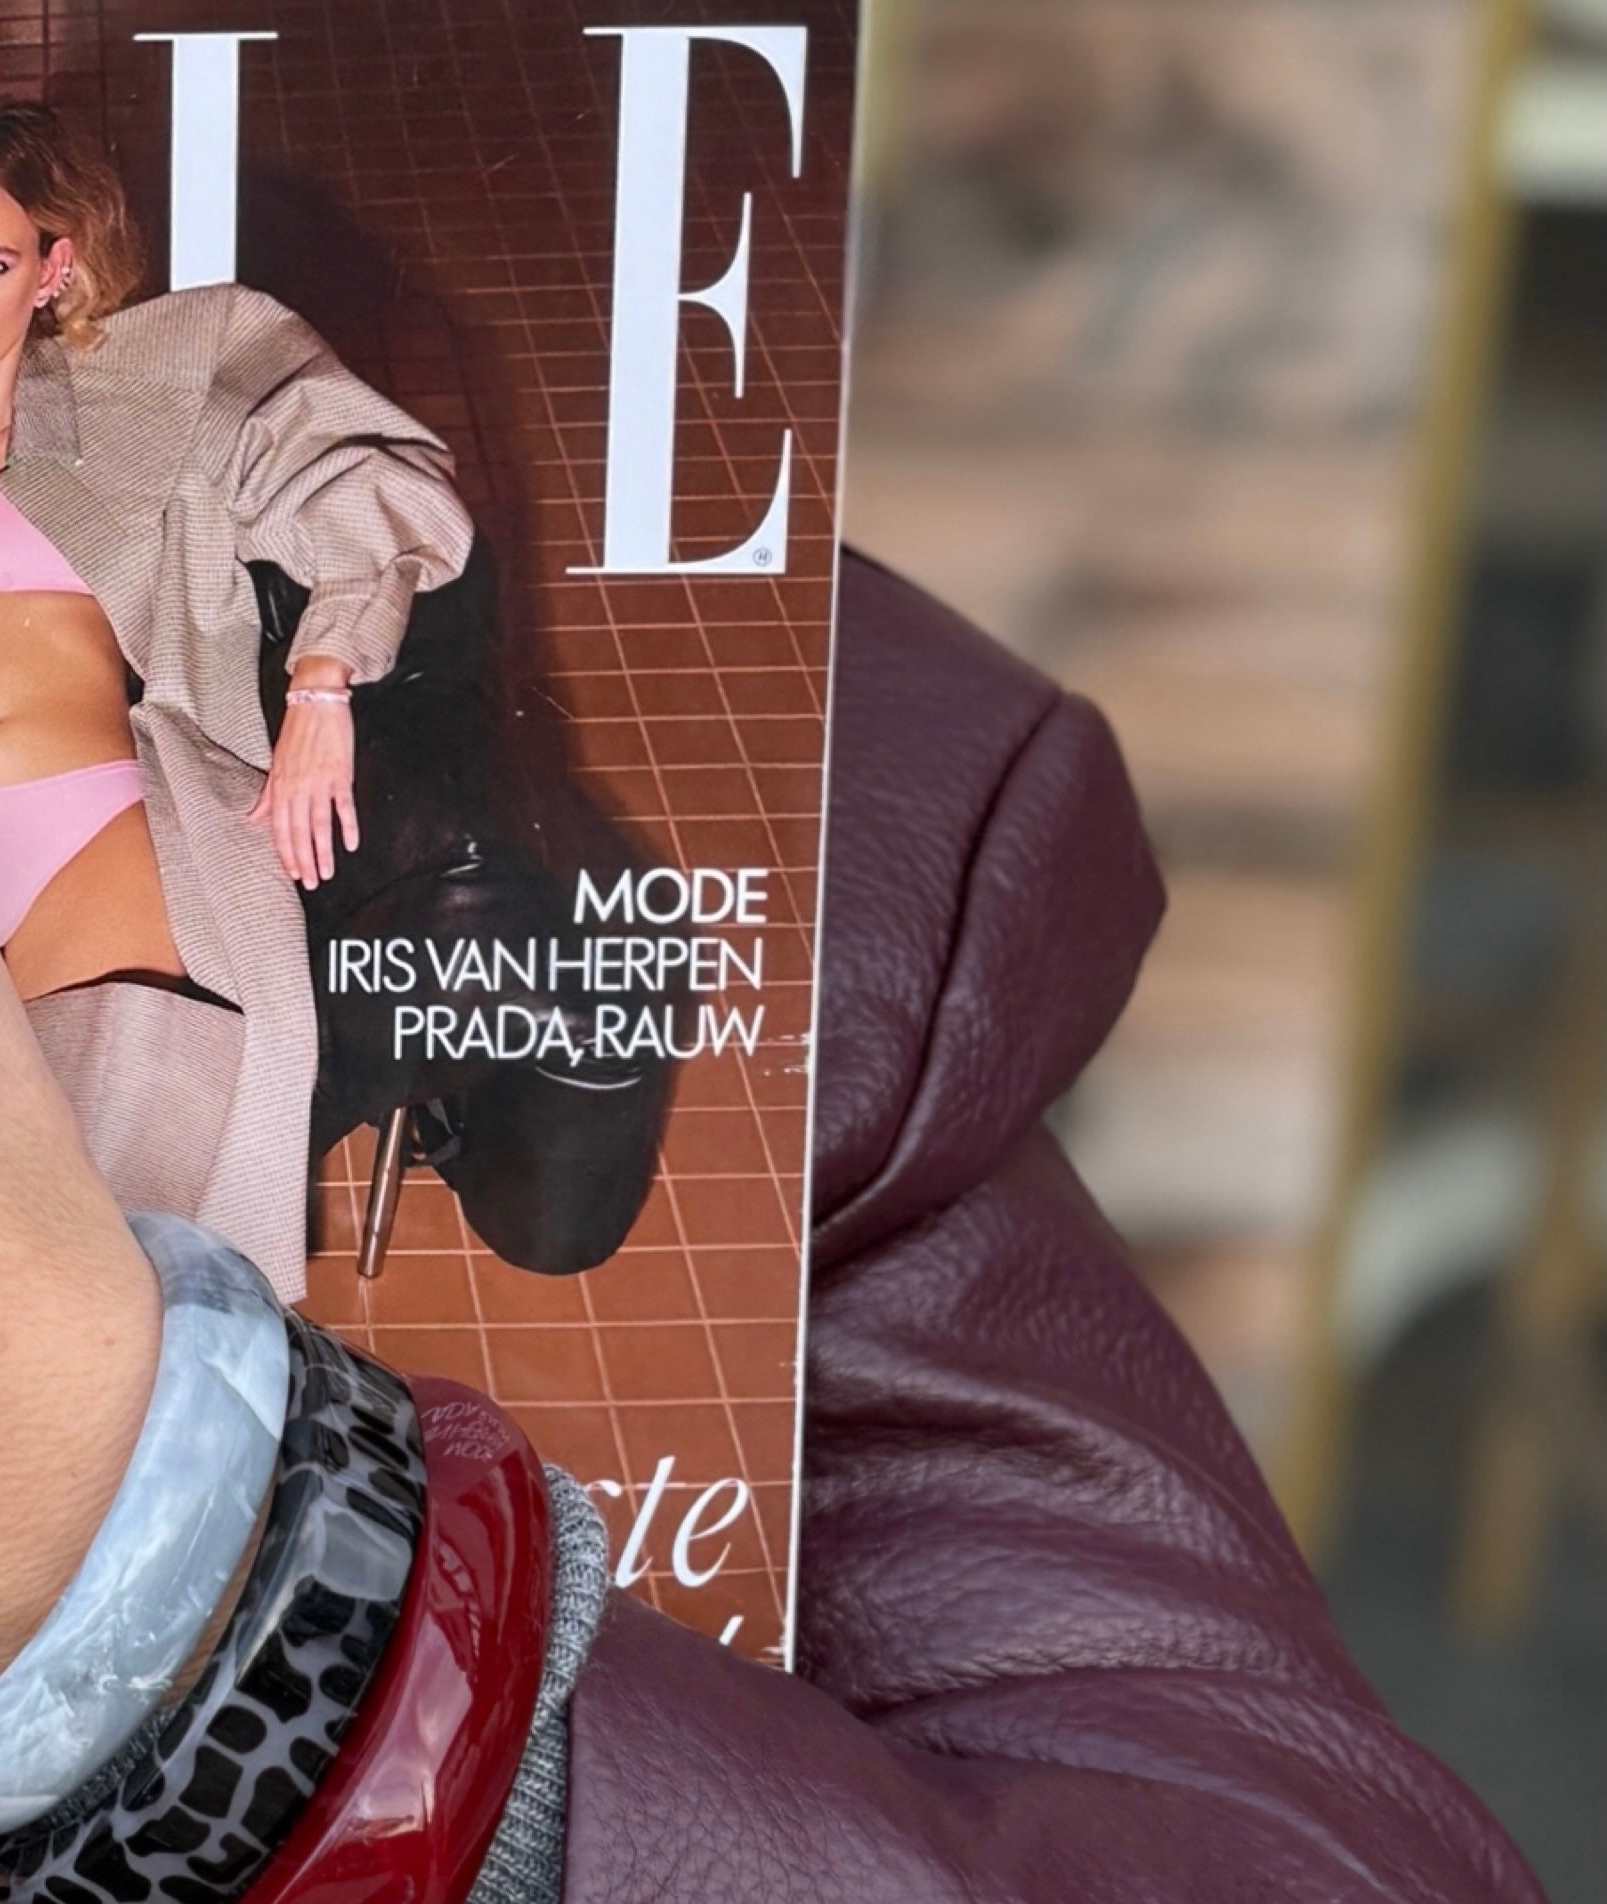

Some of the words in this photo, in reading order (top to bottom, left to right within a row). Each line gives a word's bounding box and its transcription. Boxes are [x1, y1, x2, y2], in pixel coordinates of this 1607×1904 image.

[573, 868, 768, 924] MODE
[328, 937, 417, 993] IRIS
[424, 937, 536, 992] VAN
[548, 937, 763, 991] HERPEN
[394, 1005, 584, 1067] PRADA,
[594, 1005, 765, 1060] RAUW
